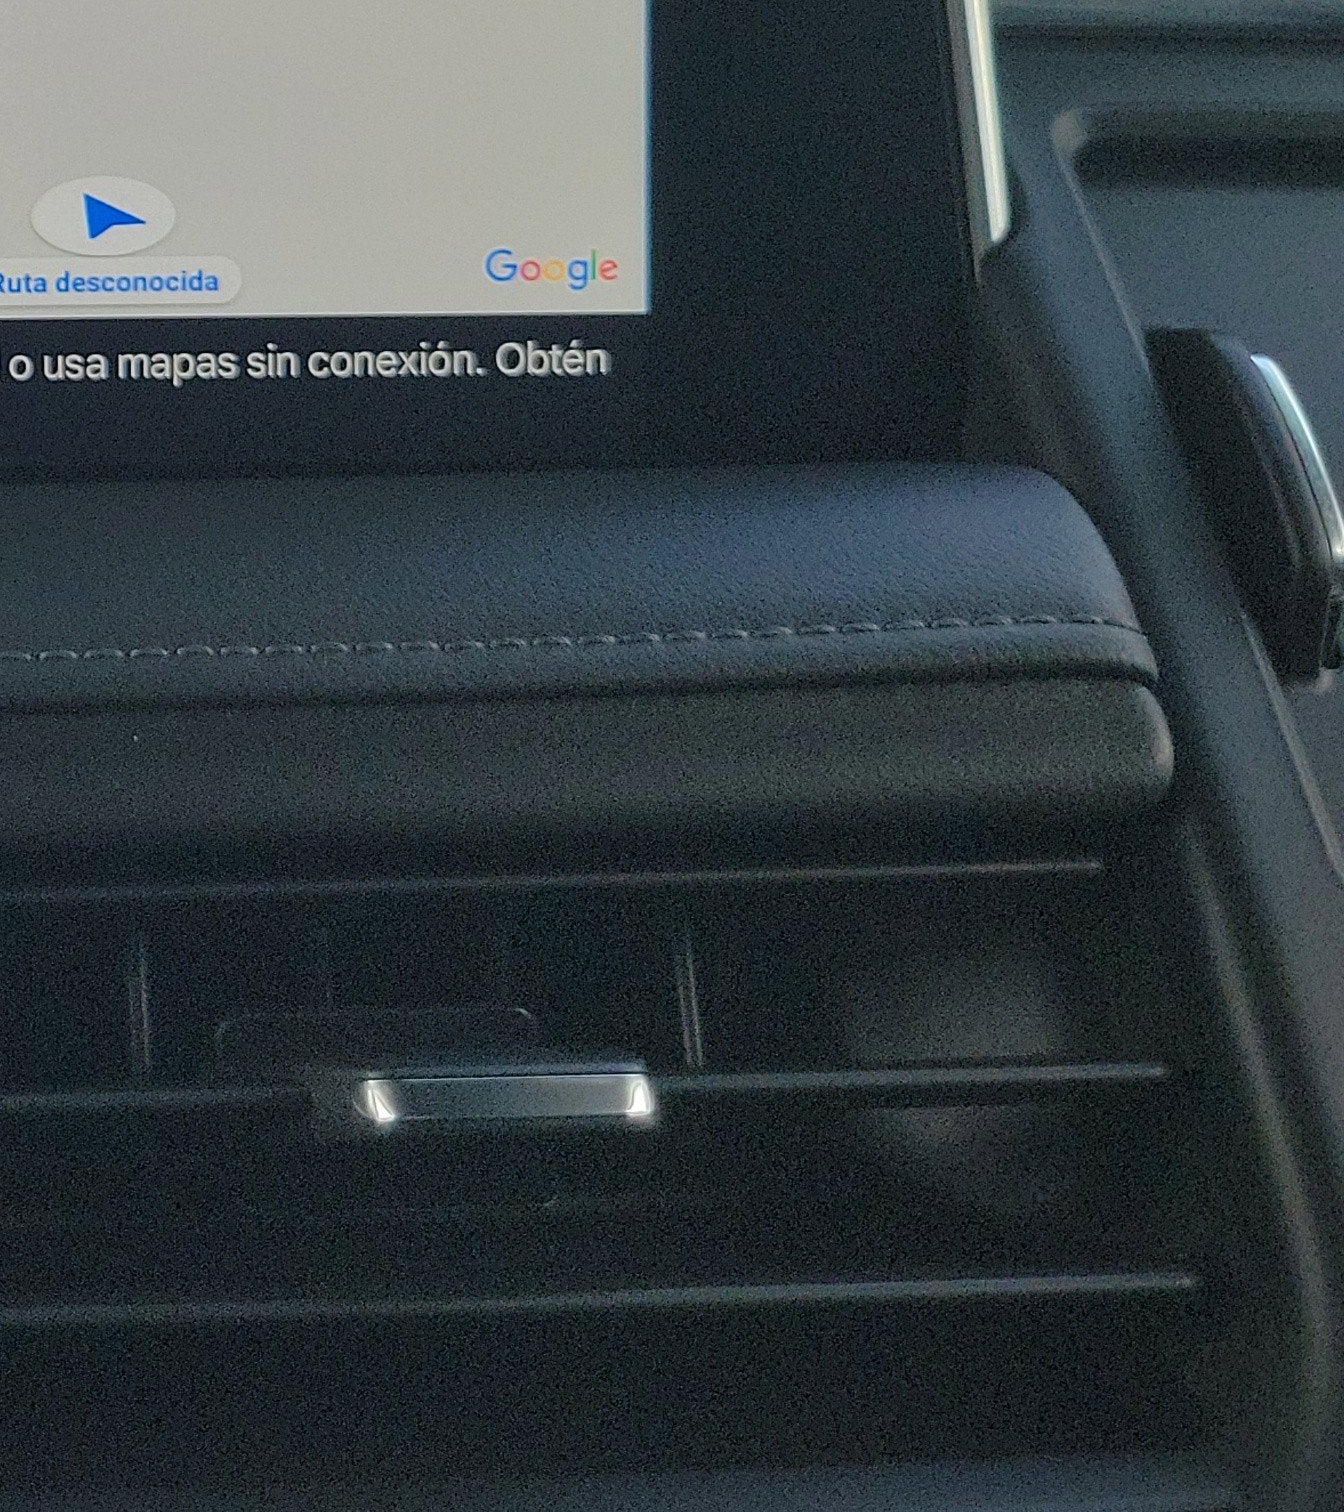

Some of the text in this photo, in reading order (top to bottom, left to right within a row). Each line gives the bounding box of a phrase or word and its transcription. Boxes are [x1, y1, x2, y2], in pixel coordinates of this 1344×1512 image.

[54, 271, 220, 294] desconocida
[485, 248, 619, 292] Google
[8, 354, 33, 381] o
[43, 353, 109, 381] usa
[118, 352, 238, 387] mapas
[246, 342, 300, 379] sin
[308, 340, 486, 378] conexión.
[496, 339, 608, 376] Obtén
